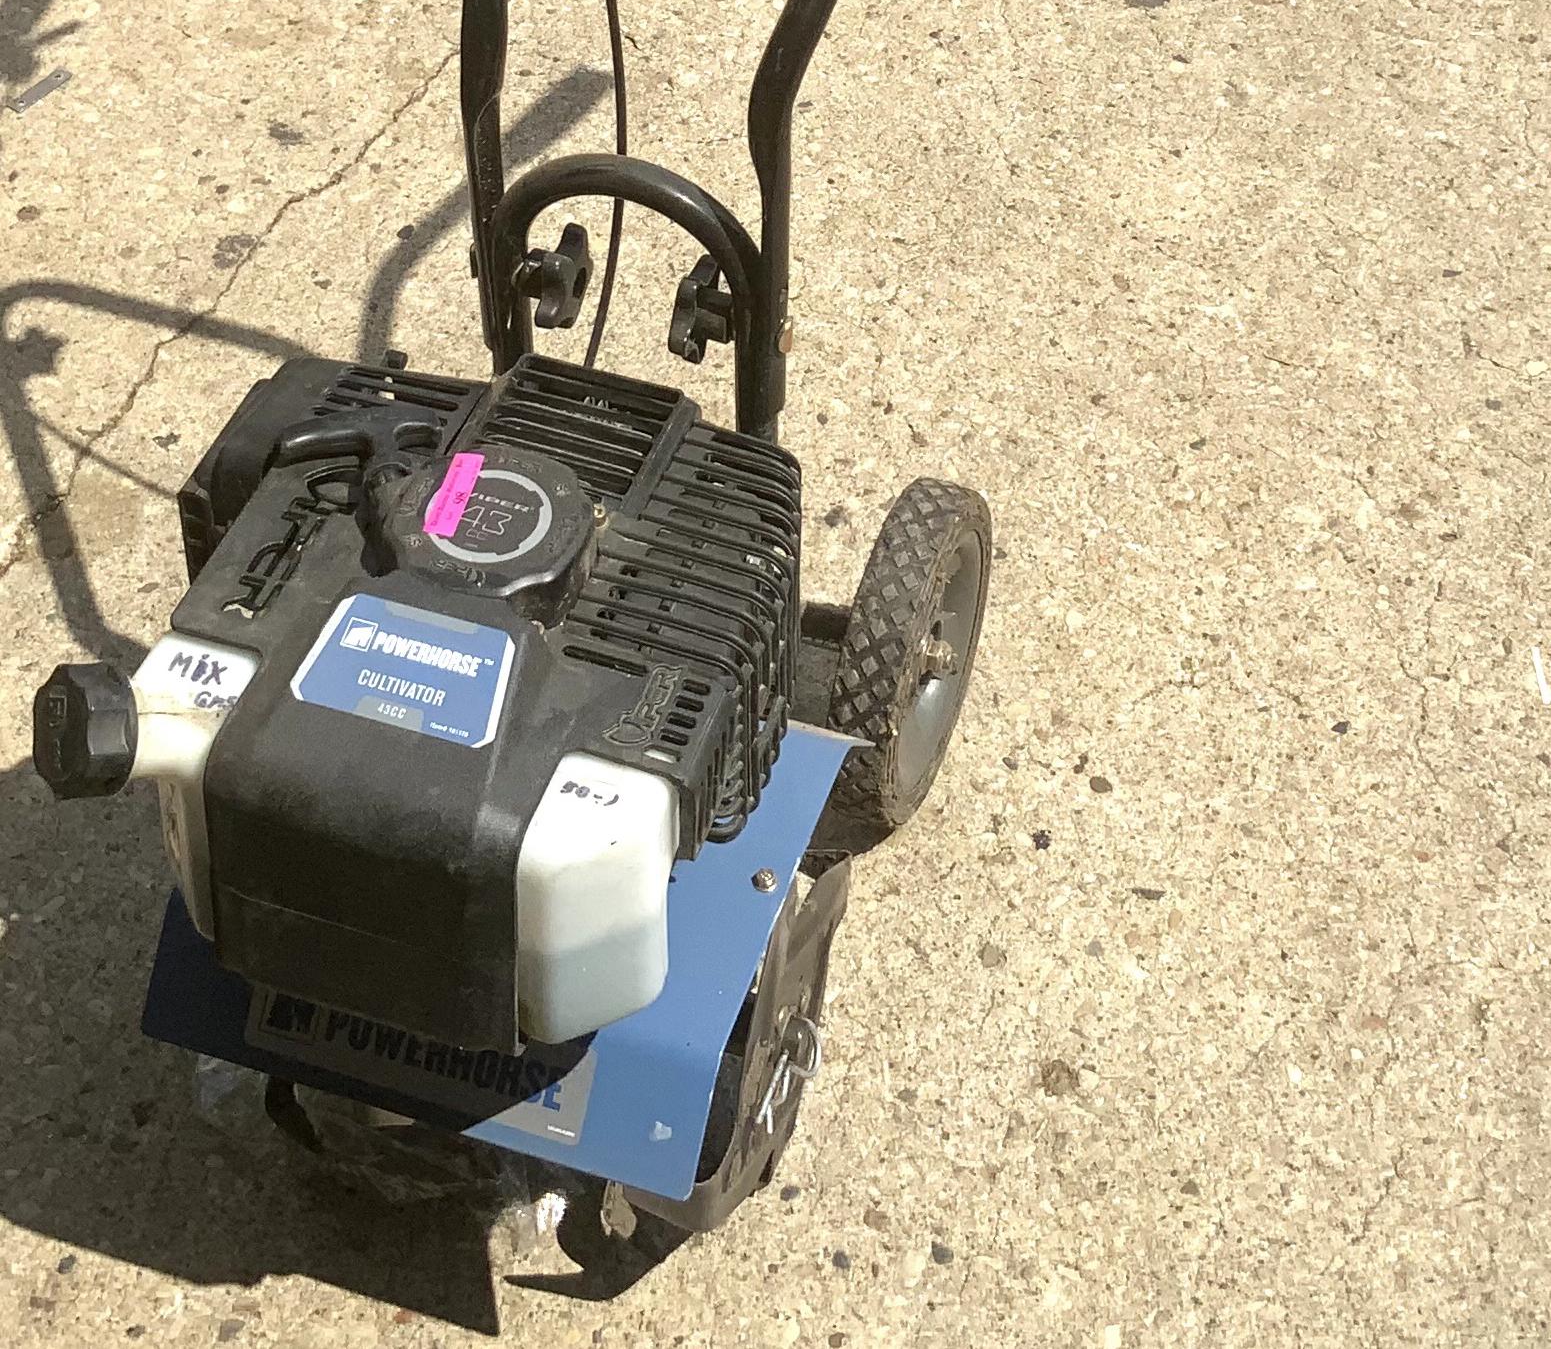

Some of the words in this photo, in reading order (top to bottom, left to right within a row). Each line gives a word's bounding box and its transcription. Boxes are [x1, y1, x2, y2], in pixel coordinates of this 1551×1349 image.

[461, 505, 512, 535] 43
[372, 632, 482, 677] POWERHORSE
[357, 669, 446, 706] CULTIVATOR
[377, 703, 407, 719] 43CC
